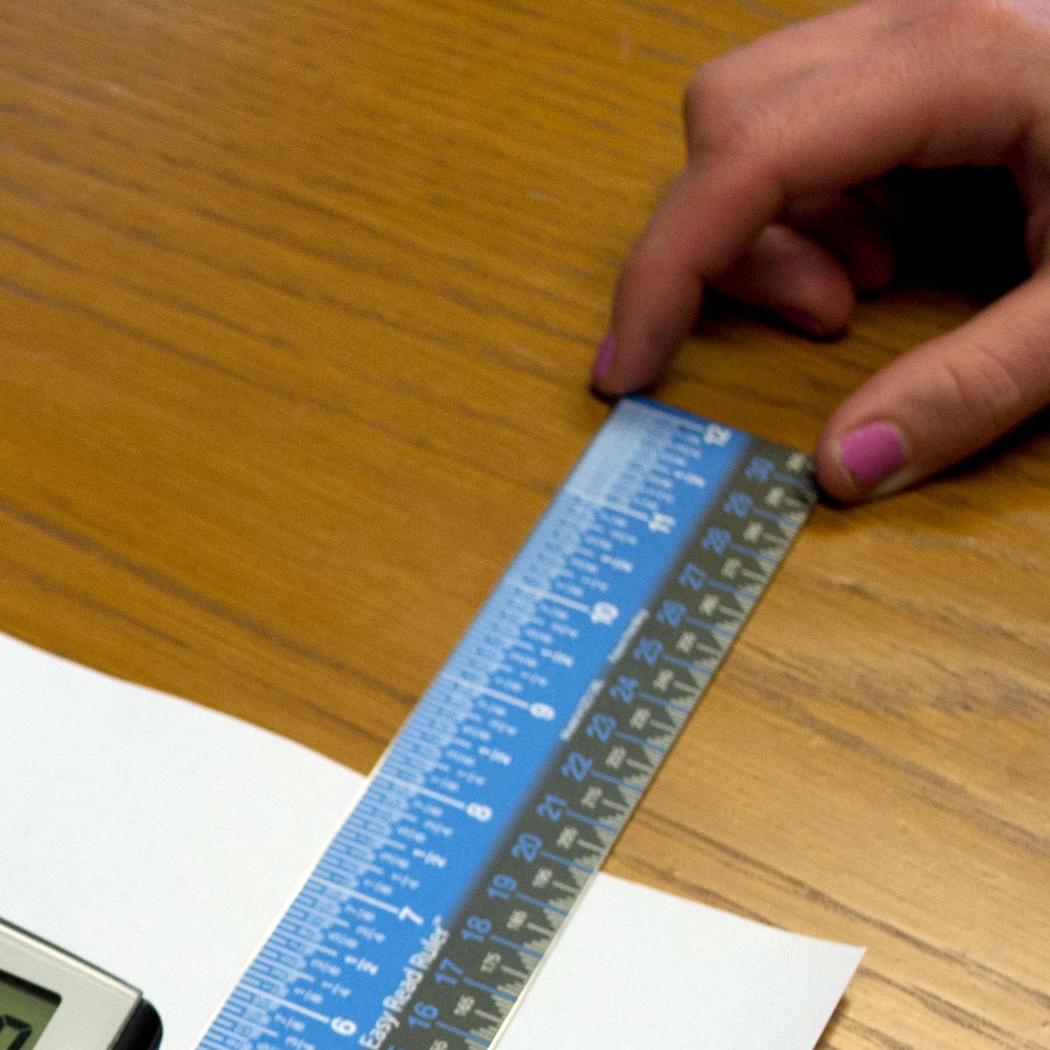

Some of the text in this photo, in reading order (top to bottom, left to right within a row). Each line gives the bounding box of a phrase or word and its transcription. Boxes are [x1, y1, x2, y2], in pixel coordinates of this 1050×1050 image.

[647, 511, 676, 534] 11
[589, 601, 619, 625] 10
[465, 802, 493, 822] 8
[487, 873, 518, 900] 19
[397, 905, 424, 926] 7
[460, 915, 493, 942] 18
[433, 957, 464, 985] 17
[358, 1013, 401, 1050] Easy
[382, 969, 425, 1010] Read
[407, 1001, 439, 1029] 16
[329, 1016, 358, 1036] 6
